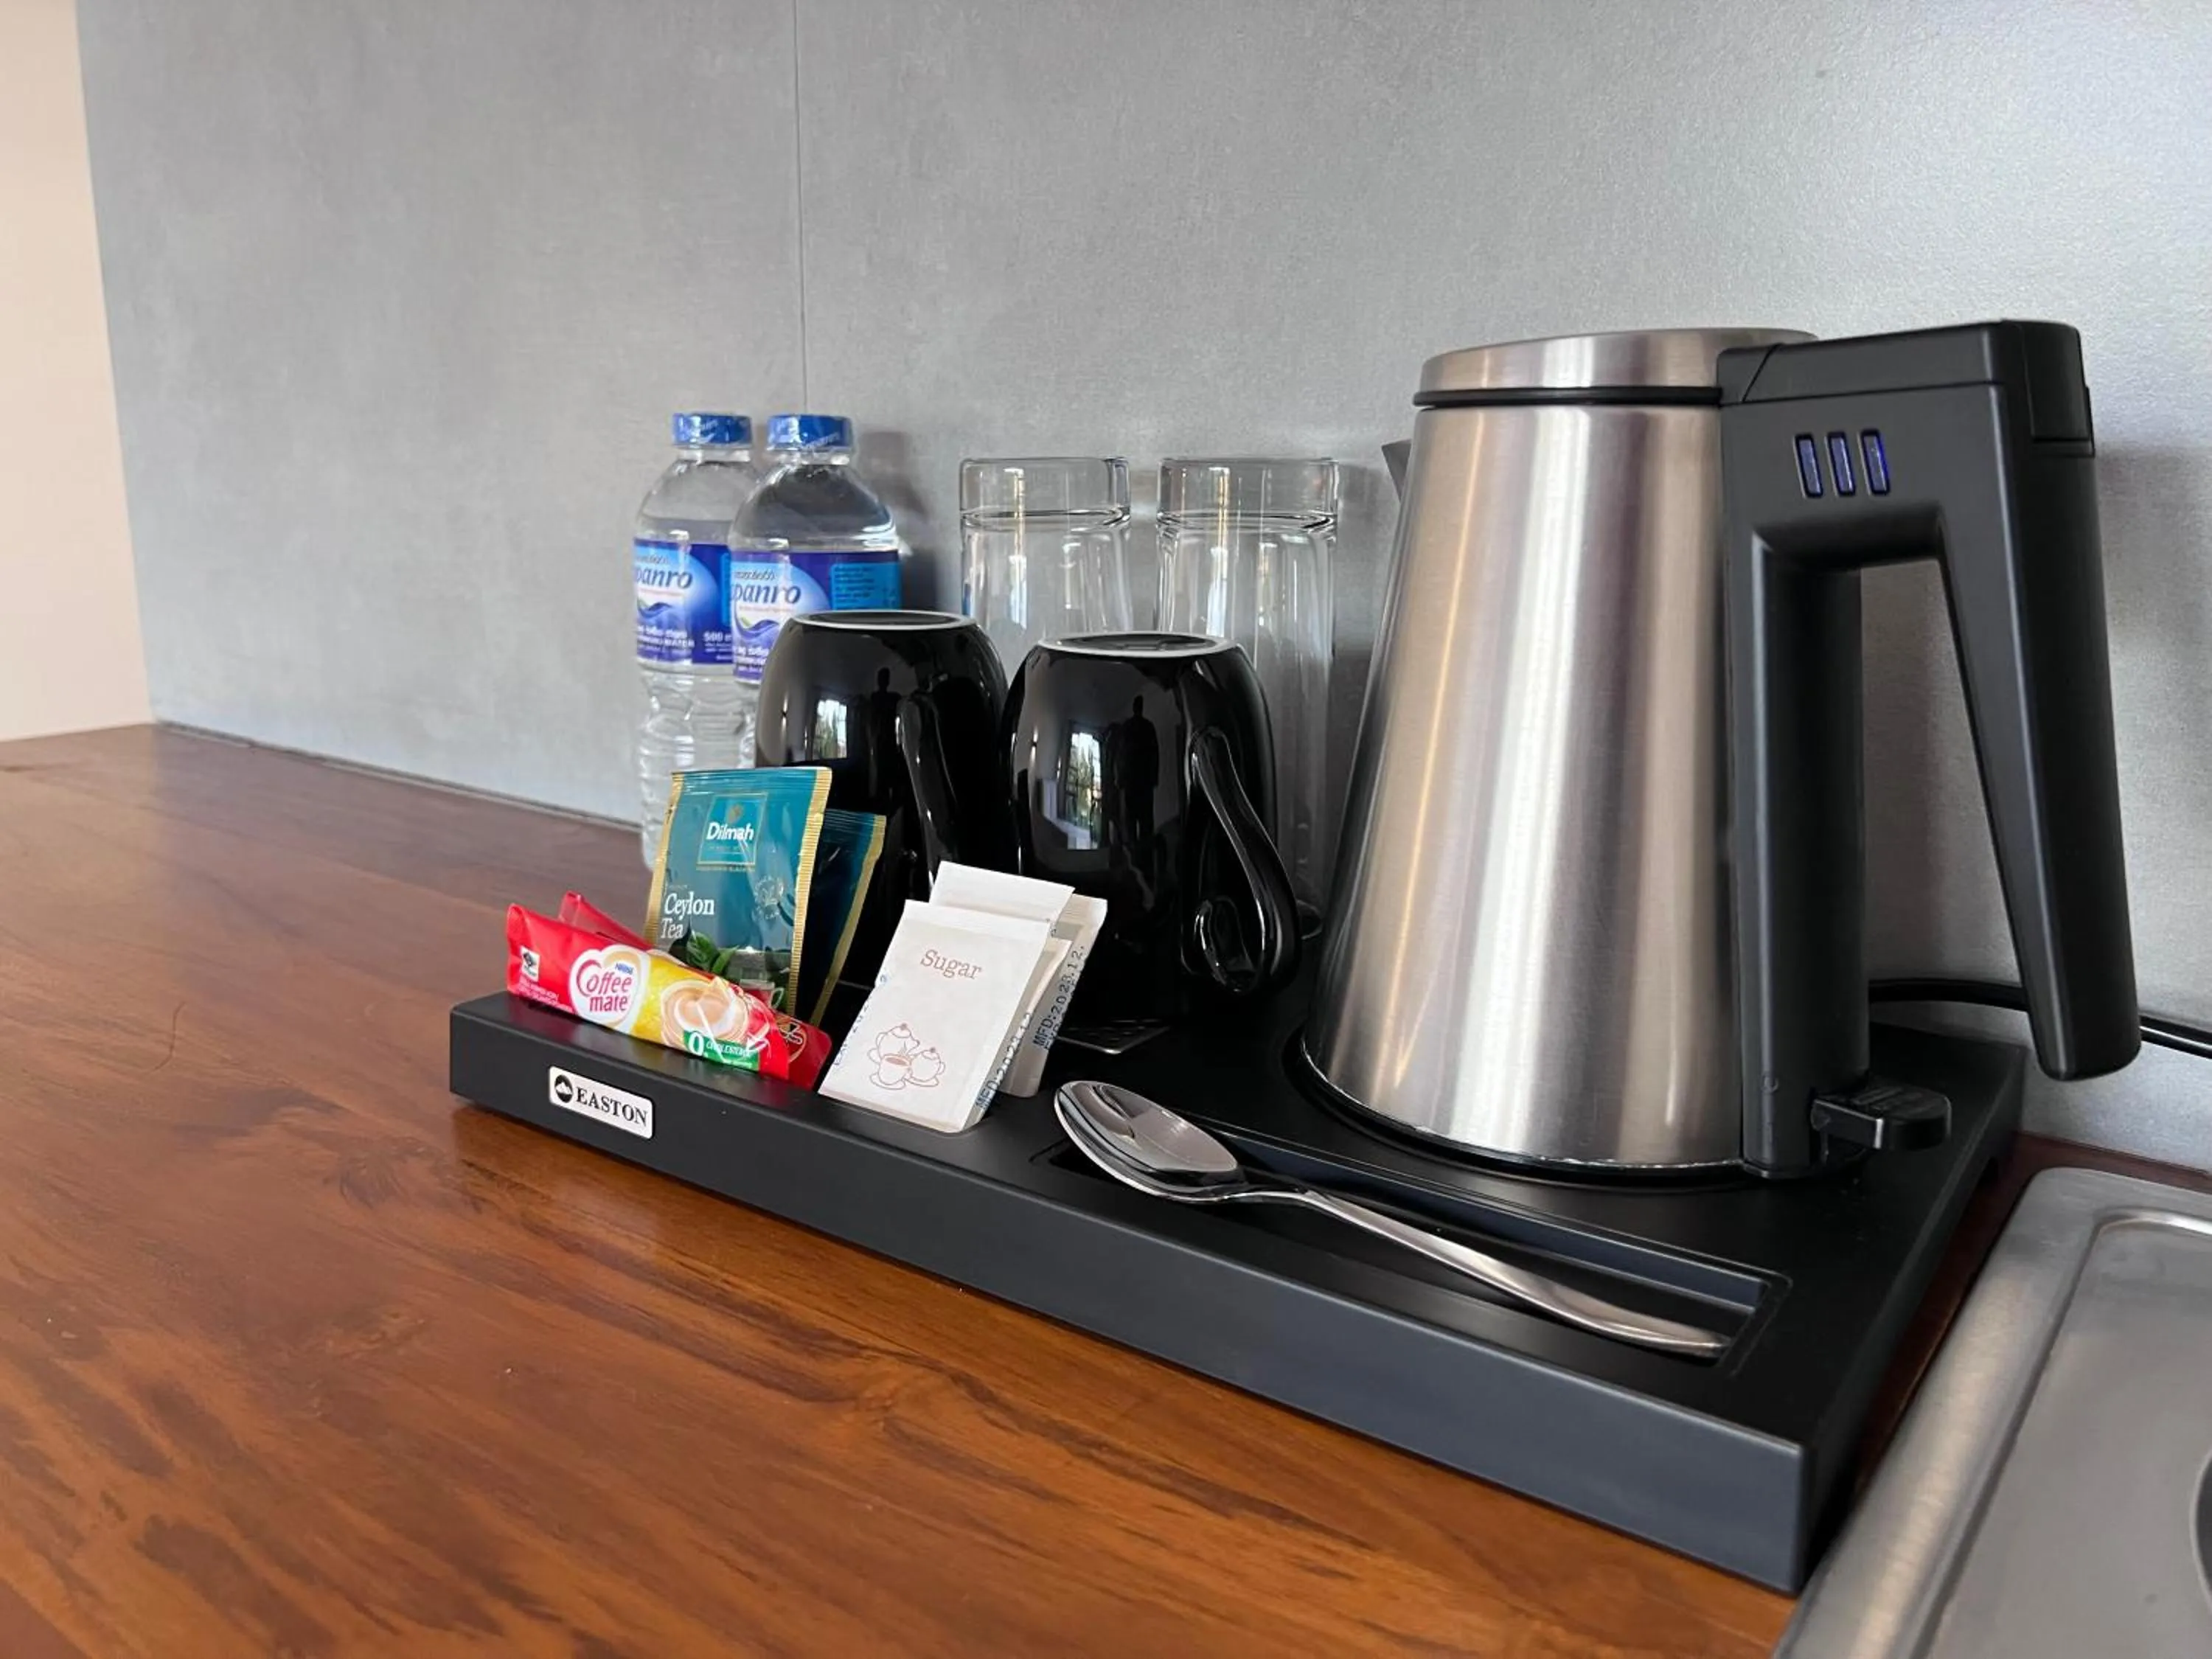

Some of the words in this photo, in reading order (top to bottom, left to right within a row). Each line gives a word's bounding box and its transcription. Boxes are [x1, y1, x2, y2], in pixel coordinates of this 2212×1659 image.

[706, 821, 754, 841] Dilmah
[664, 890, 715, 921] Ceylon
[661, 917, 684, 939] Tea
[576, 959, 633, 998] Coffee
[919, 949, 984, 980] Sugar
[589, 995, 628, 1013] mate
[576, 1087, 647, 1127] EASTON
